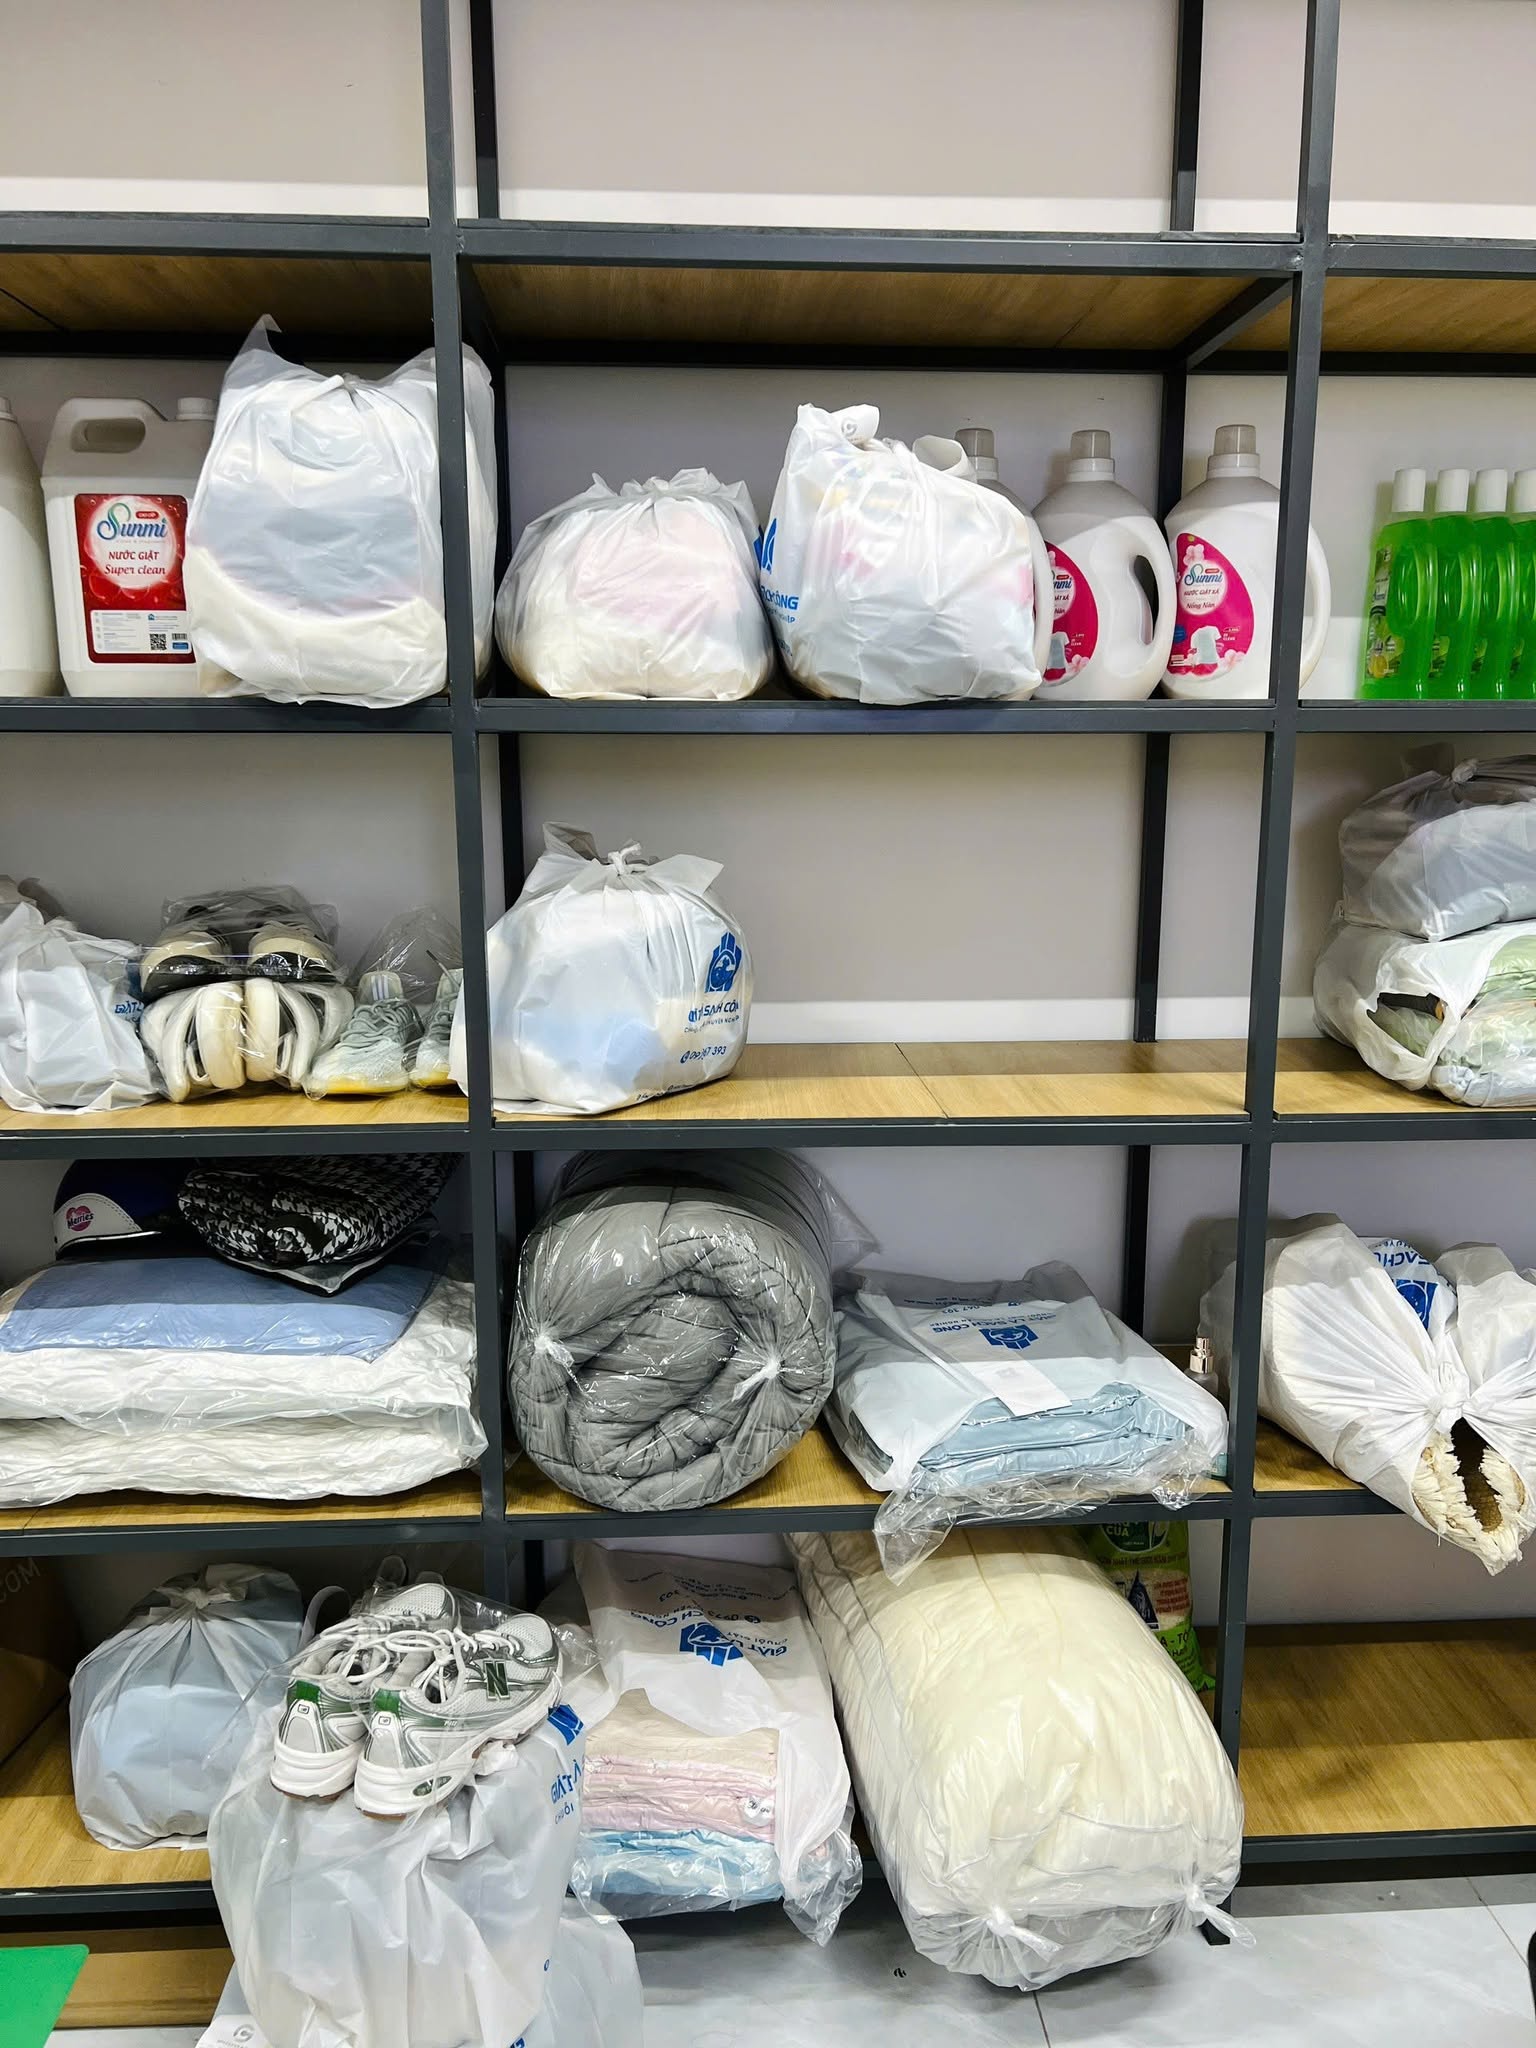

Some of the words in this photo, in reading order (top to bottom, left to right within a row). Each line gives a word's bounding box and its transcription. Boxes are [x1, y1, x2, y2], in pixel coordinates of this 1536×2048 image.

[97, 502, 168, 541] Sunmi
[109, 549, 136, 561] NƯỚC
[138, 550, 160, 562] GIẶT
[104, 564, 135, 576] Super
[138, 565, 166, 575] clean
[1184, 563, 1224, 586] Sunmi
[1053, 576, 1072, 590] nmi
[67, 1213, 94, 1229] Merries
[932, 1323, 970, 1334] CÔNG
[681, 1610, 704, 1621] CH
[749, 1643, 787, 1658] GIẶT
